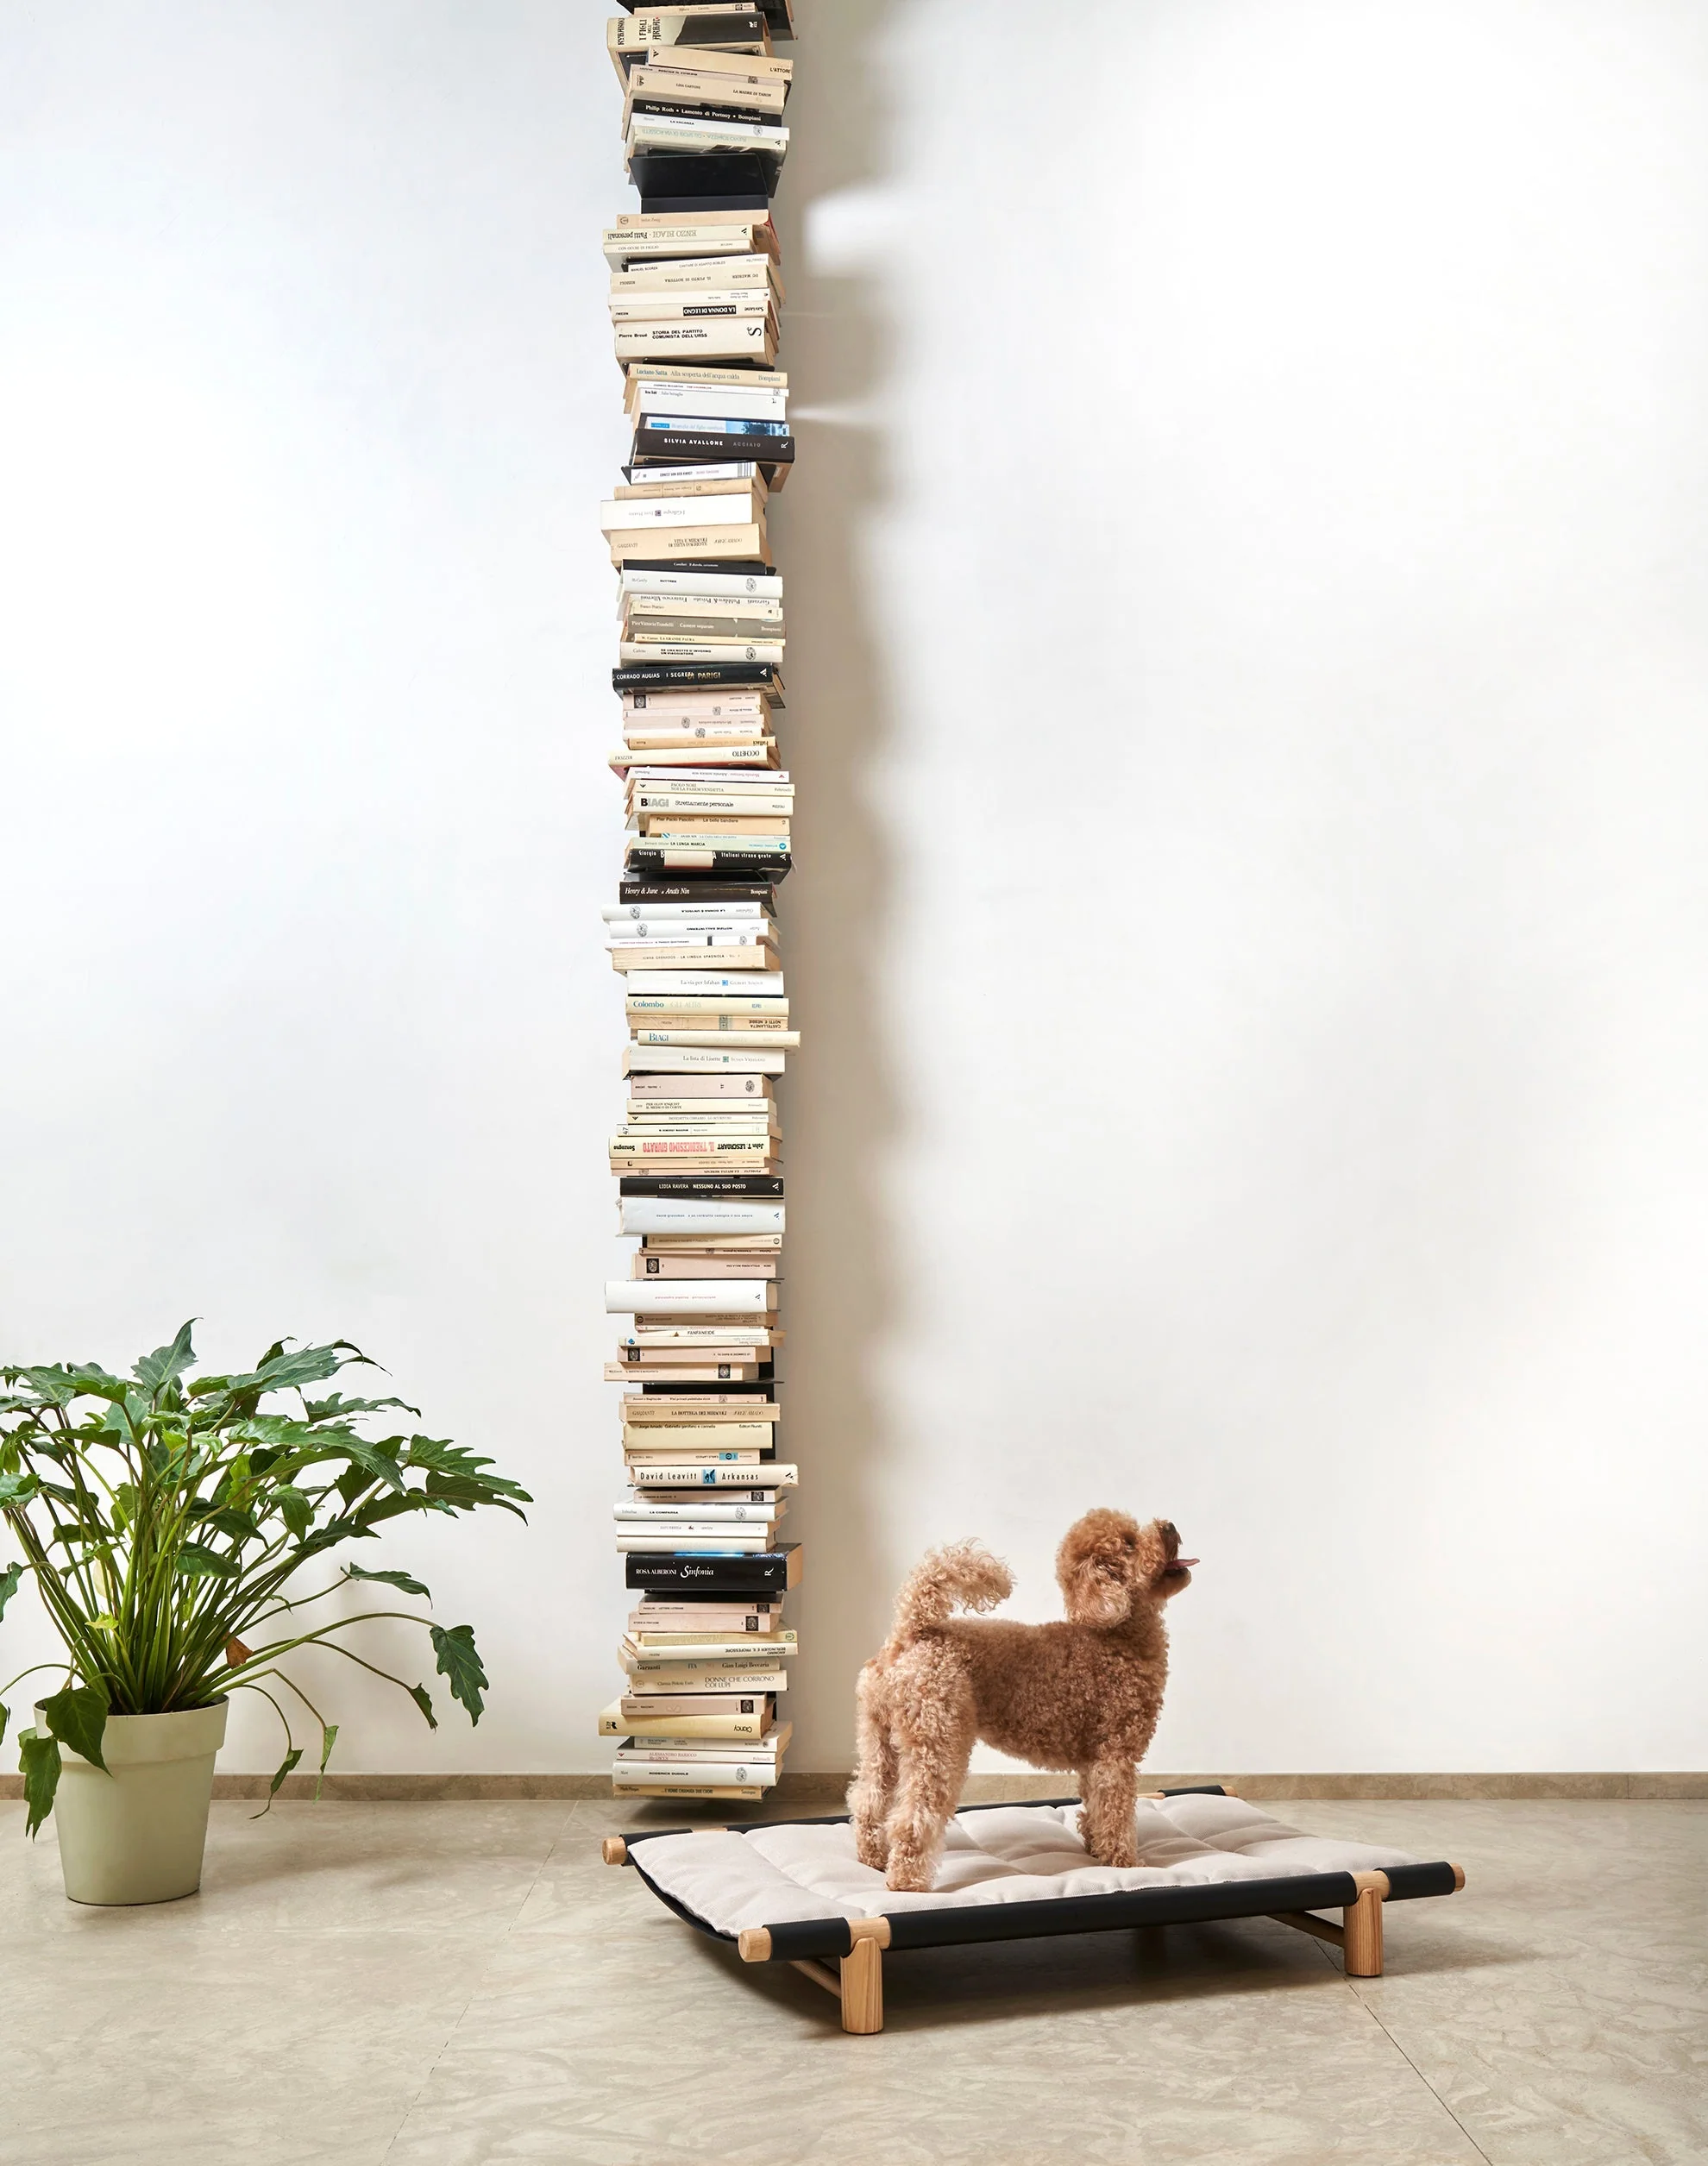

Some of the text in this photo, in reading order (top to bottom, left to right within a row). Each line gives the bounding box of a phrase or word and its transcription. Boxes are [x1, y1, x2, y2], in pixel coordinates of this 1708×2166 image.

[738, 113, 761, 122] Bompiani
[640, 798, 669, 807] BIAGI
[649, 1033, 669, 1042] BIAGI
[643, 1142, 668, 1152] GIURATO
[669, 1142, 707, 1152] TREDICESIMO
[708, 1141, 714, 1152] IL
[681, 1565, 714, 1579] Sinfonia
